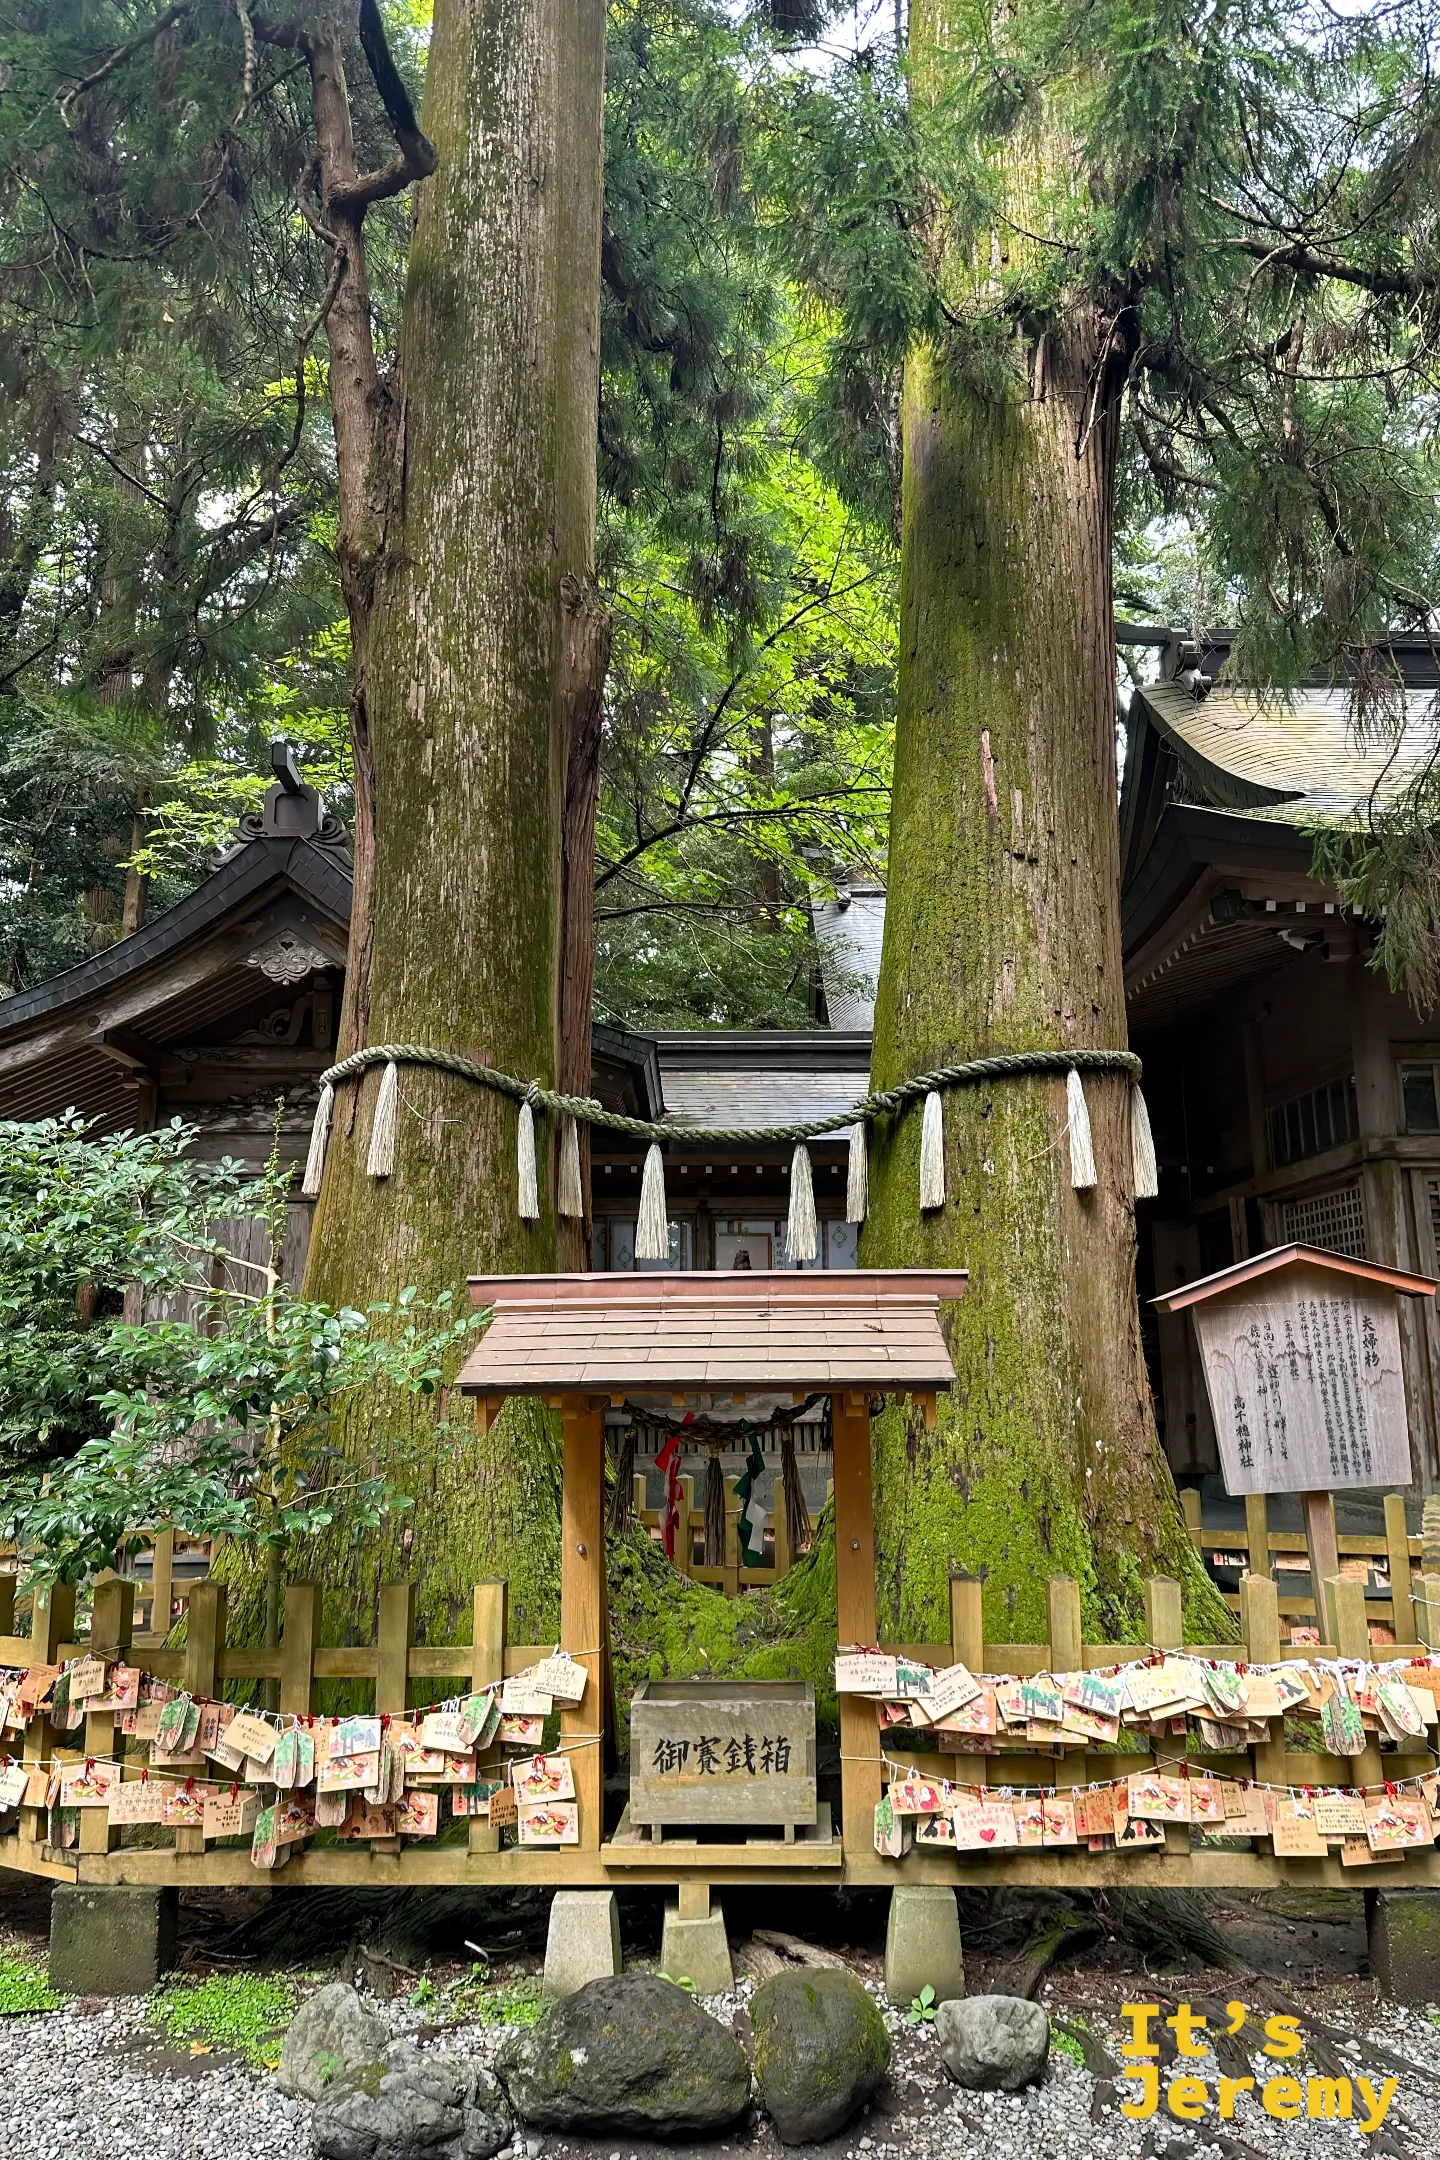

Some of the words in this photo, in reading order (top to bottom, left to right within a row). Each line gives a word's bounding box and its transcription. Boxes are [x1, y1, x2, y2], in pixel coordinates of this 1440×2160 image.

[1362, 1315, 1380, 1368] 夫婦杉
[1234, 1395, 1254, 1468] 高千穂神社
[652, 1733, 792, 1776] 御賽銭箱
